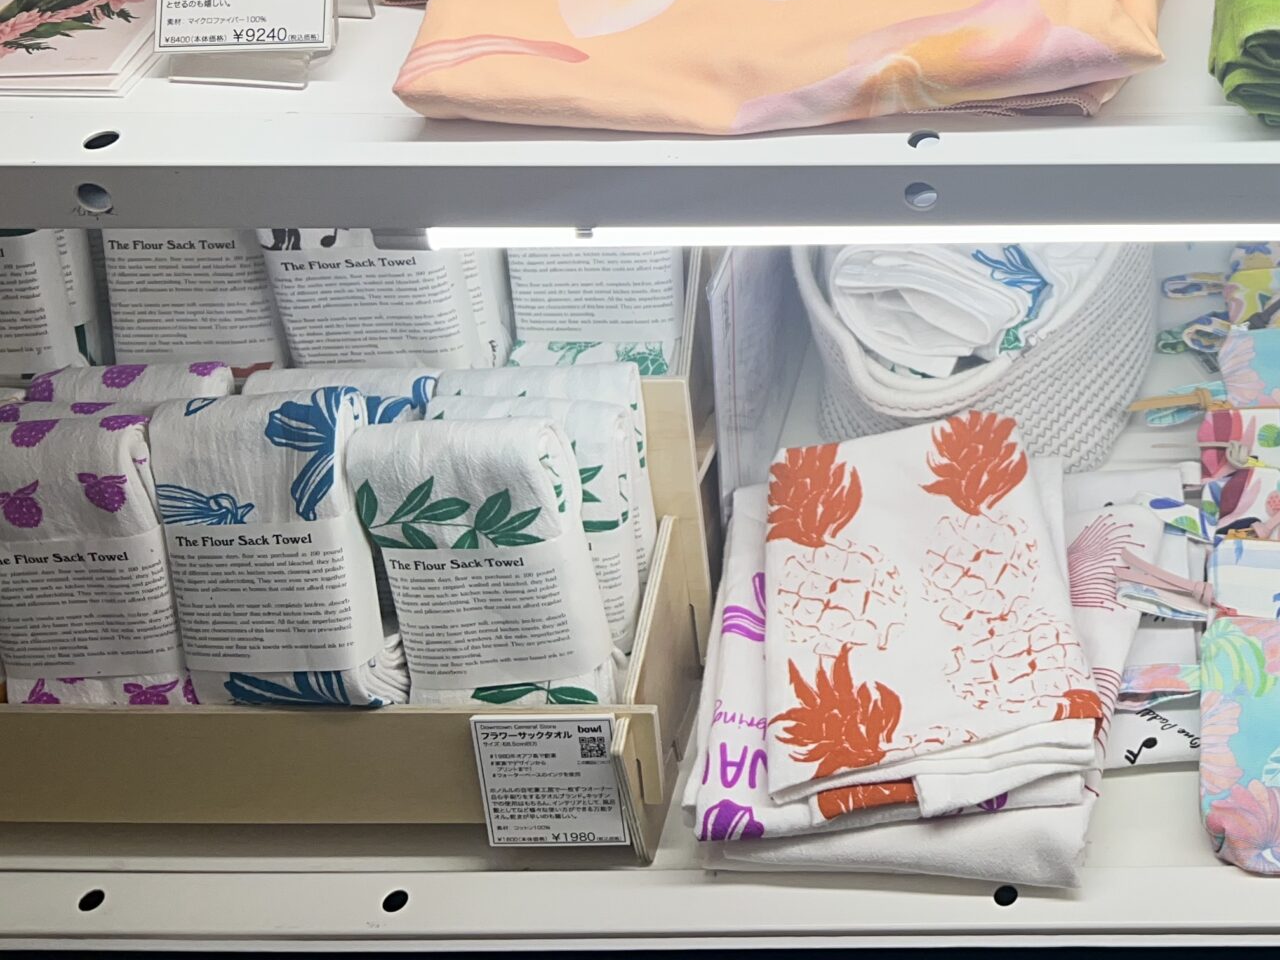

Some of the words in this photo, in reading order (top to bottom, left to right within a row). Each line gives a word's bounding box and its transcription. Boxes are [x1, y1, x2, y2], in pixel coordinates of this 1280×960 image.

[232, 27, 288, 42] ¥9240
[108, 240, 130, 251] The
[132, 240, 164, 251] Flour
[166, 239, 197, 250] Sack
[199, 240, 236, 250] Towel
[281, 261, 306, 272] The
[308, 259, 340, 271] Flour
[343, 257, 376, 269] Sack
[378, 255, 417, 268] Towel
[175, 536, 200, 547] The
[201, 536, 235, 547] Flour
[238, 534, 270, 546] Sack
[272, 534, 313, 545] Towel
[14, 554, 49, 565] Flour
[53, 553, 85, 563] Sack
[88, 551, 129, 562] Towel
[389, 559, 411, 571] The
[414, 559, 447, 571] Flour
[450, 558, 483, 569] Sack
[484, 557, 524, 567] Towel
[480, 731, 573, 740] フラワーサックタオル
[577, 725, 602, 733] bowl
[551, 832, 596, 842] ¥1980
